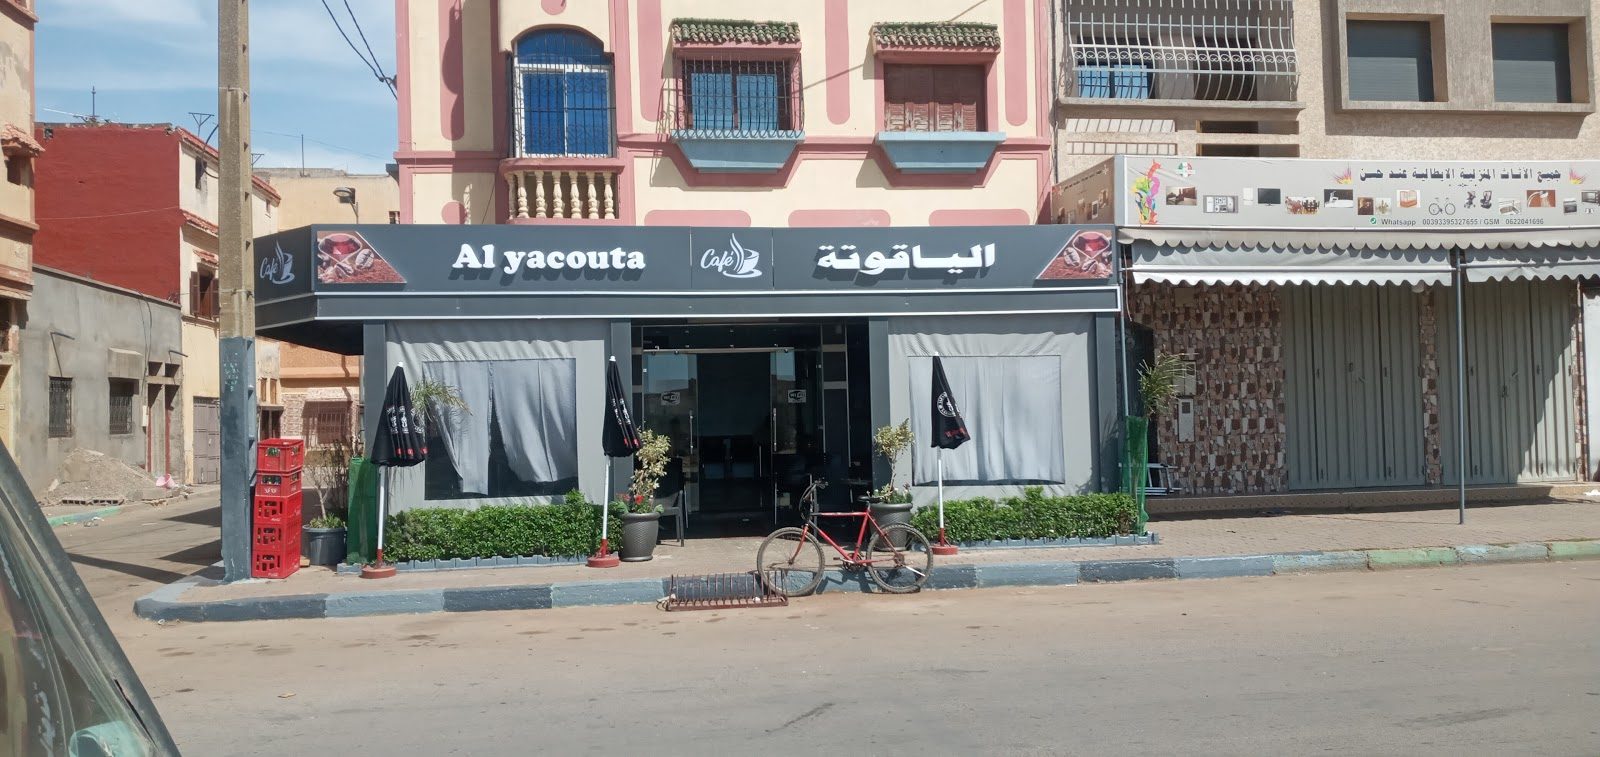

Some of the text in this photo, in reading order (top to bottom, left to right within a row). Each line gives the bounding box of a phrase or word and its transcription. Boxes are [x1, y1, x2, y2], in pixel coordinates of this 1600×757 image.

[1359, 168, 1384, 181] حسن
[1388, 168, 1408, 179] عند
[1459, 167, 1496, 182] المنزلية
[1537, 169, 1561, 183] جميع
[1381, 218, 1417, 227] Whatsapp
[1483, 218, 1500, 226] GSM
[452, 243, 646, 275] Al yacouta
[700, 248, 735, 270] Café
[817, 242, 996, 275] الياقوتة
[259, 256, 279, 281] Café
